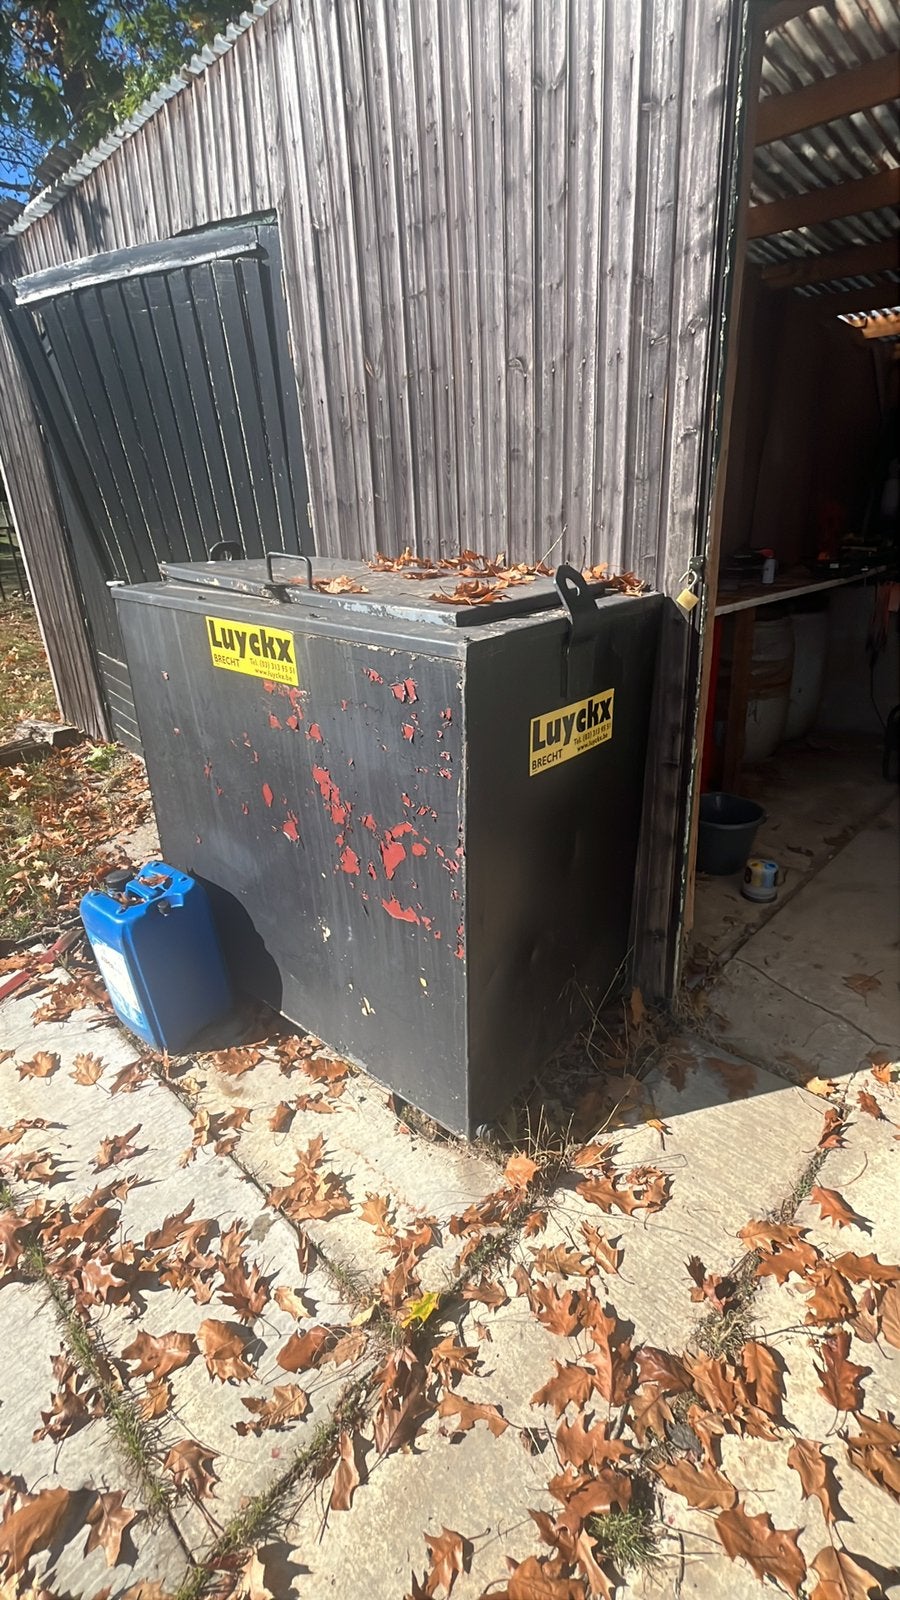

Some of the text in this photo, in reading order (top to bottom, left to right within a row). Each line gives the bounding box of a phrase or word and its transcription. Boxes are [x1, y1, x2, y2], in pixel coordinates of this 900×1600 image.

[208, 619, 293, 663] Luyckx
[213, 653, 240, 667] BRECHT
[271, 662, 280, 671] 313
[255, 669, 293, 682] www.luyckx.be
[532, 696, 612, 753] Luyckx
[532, 748, 563, 770] BRECHT
